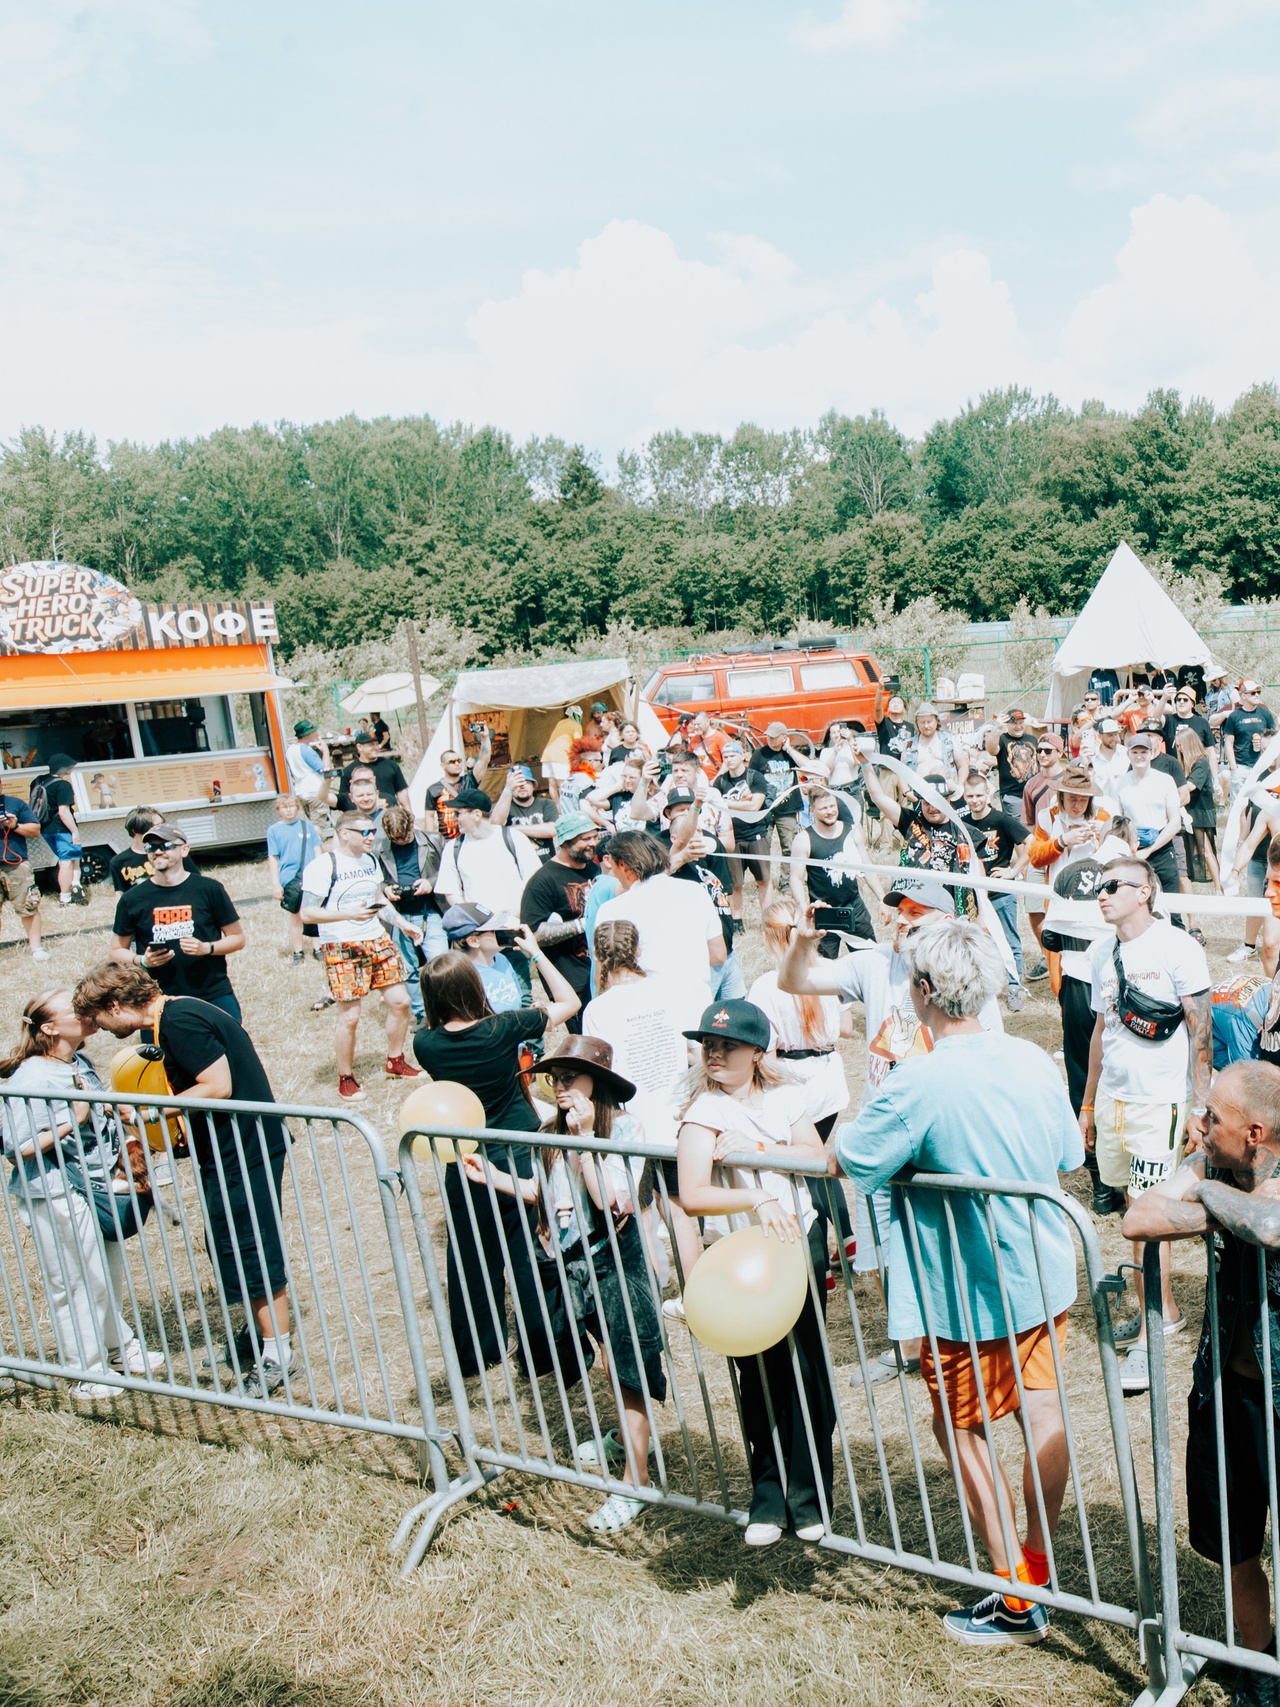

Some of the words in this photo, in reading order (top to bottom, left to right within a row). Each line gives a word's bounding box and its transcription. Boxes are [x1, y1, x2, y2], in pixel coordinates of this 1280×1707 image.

[1, 571, 95, 604] SUPER
[17, 593, 90, 619] HERO
[10, 612, 101, 643] TRUCK
[149, 608, 279, 641] КОФЕ
[336, 867, 376, 882] RAMONE
[1130, 1020, 1150, 1035] PARTY
